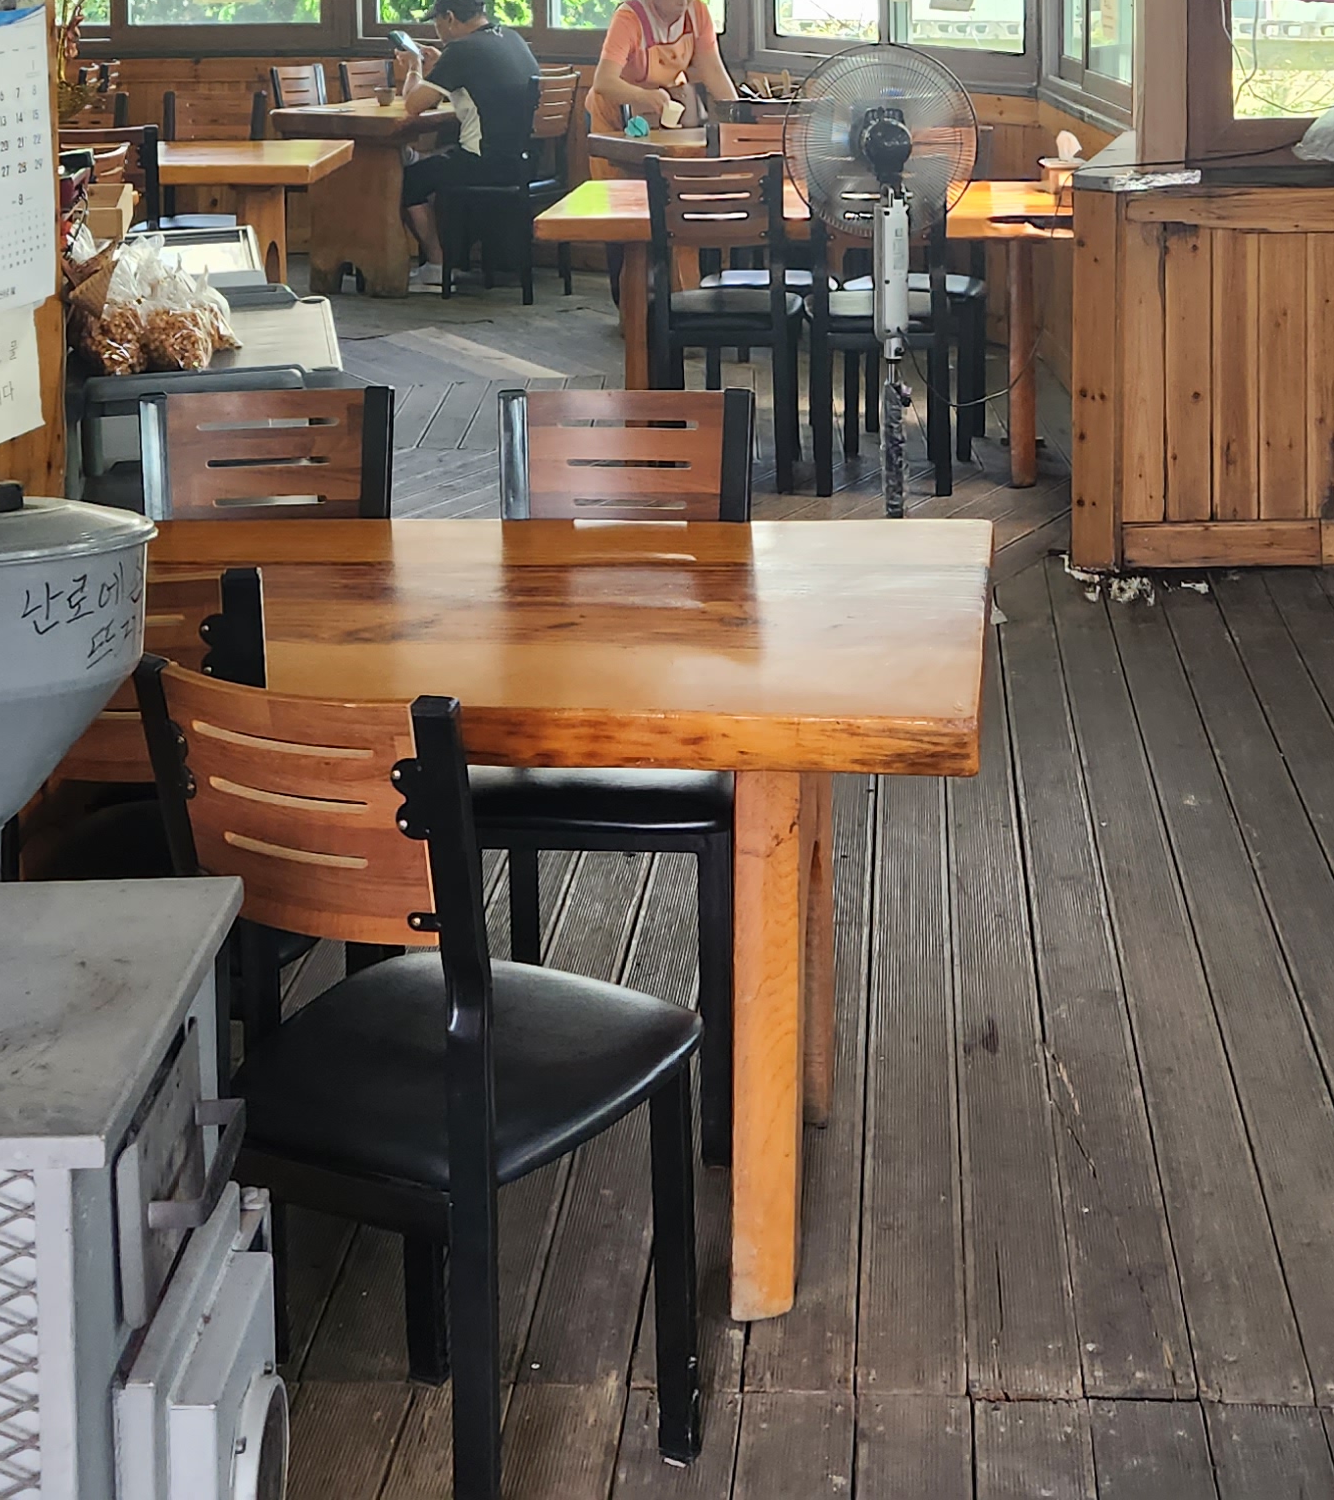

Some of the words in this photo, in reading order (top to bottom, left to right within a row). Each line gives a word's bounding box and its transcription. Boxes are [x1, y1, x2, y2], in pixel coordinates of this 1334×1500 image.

[0, 115, 7, 127] 13
[16, 112, 24, 124] 14
[0, 140, 9, 152] 20
[17, 137, 25, 149] 21
[33, 134, 41, 145] 22
[1, 165, 10, 178] 27
[9, 339, 18, 361] 물
[21, 561, 124, 635] 난로에
